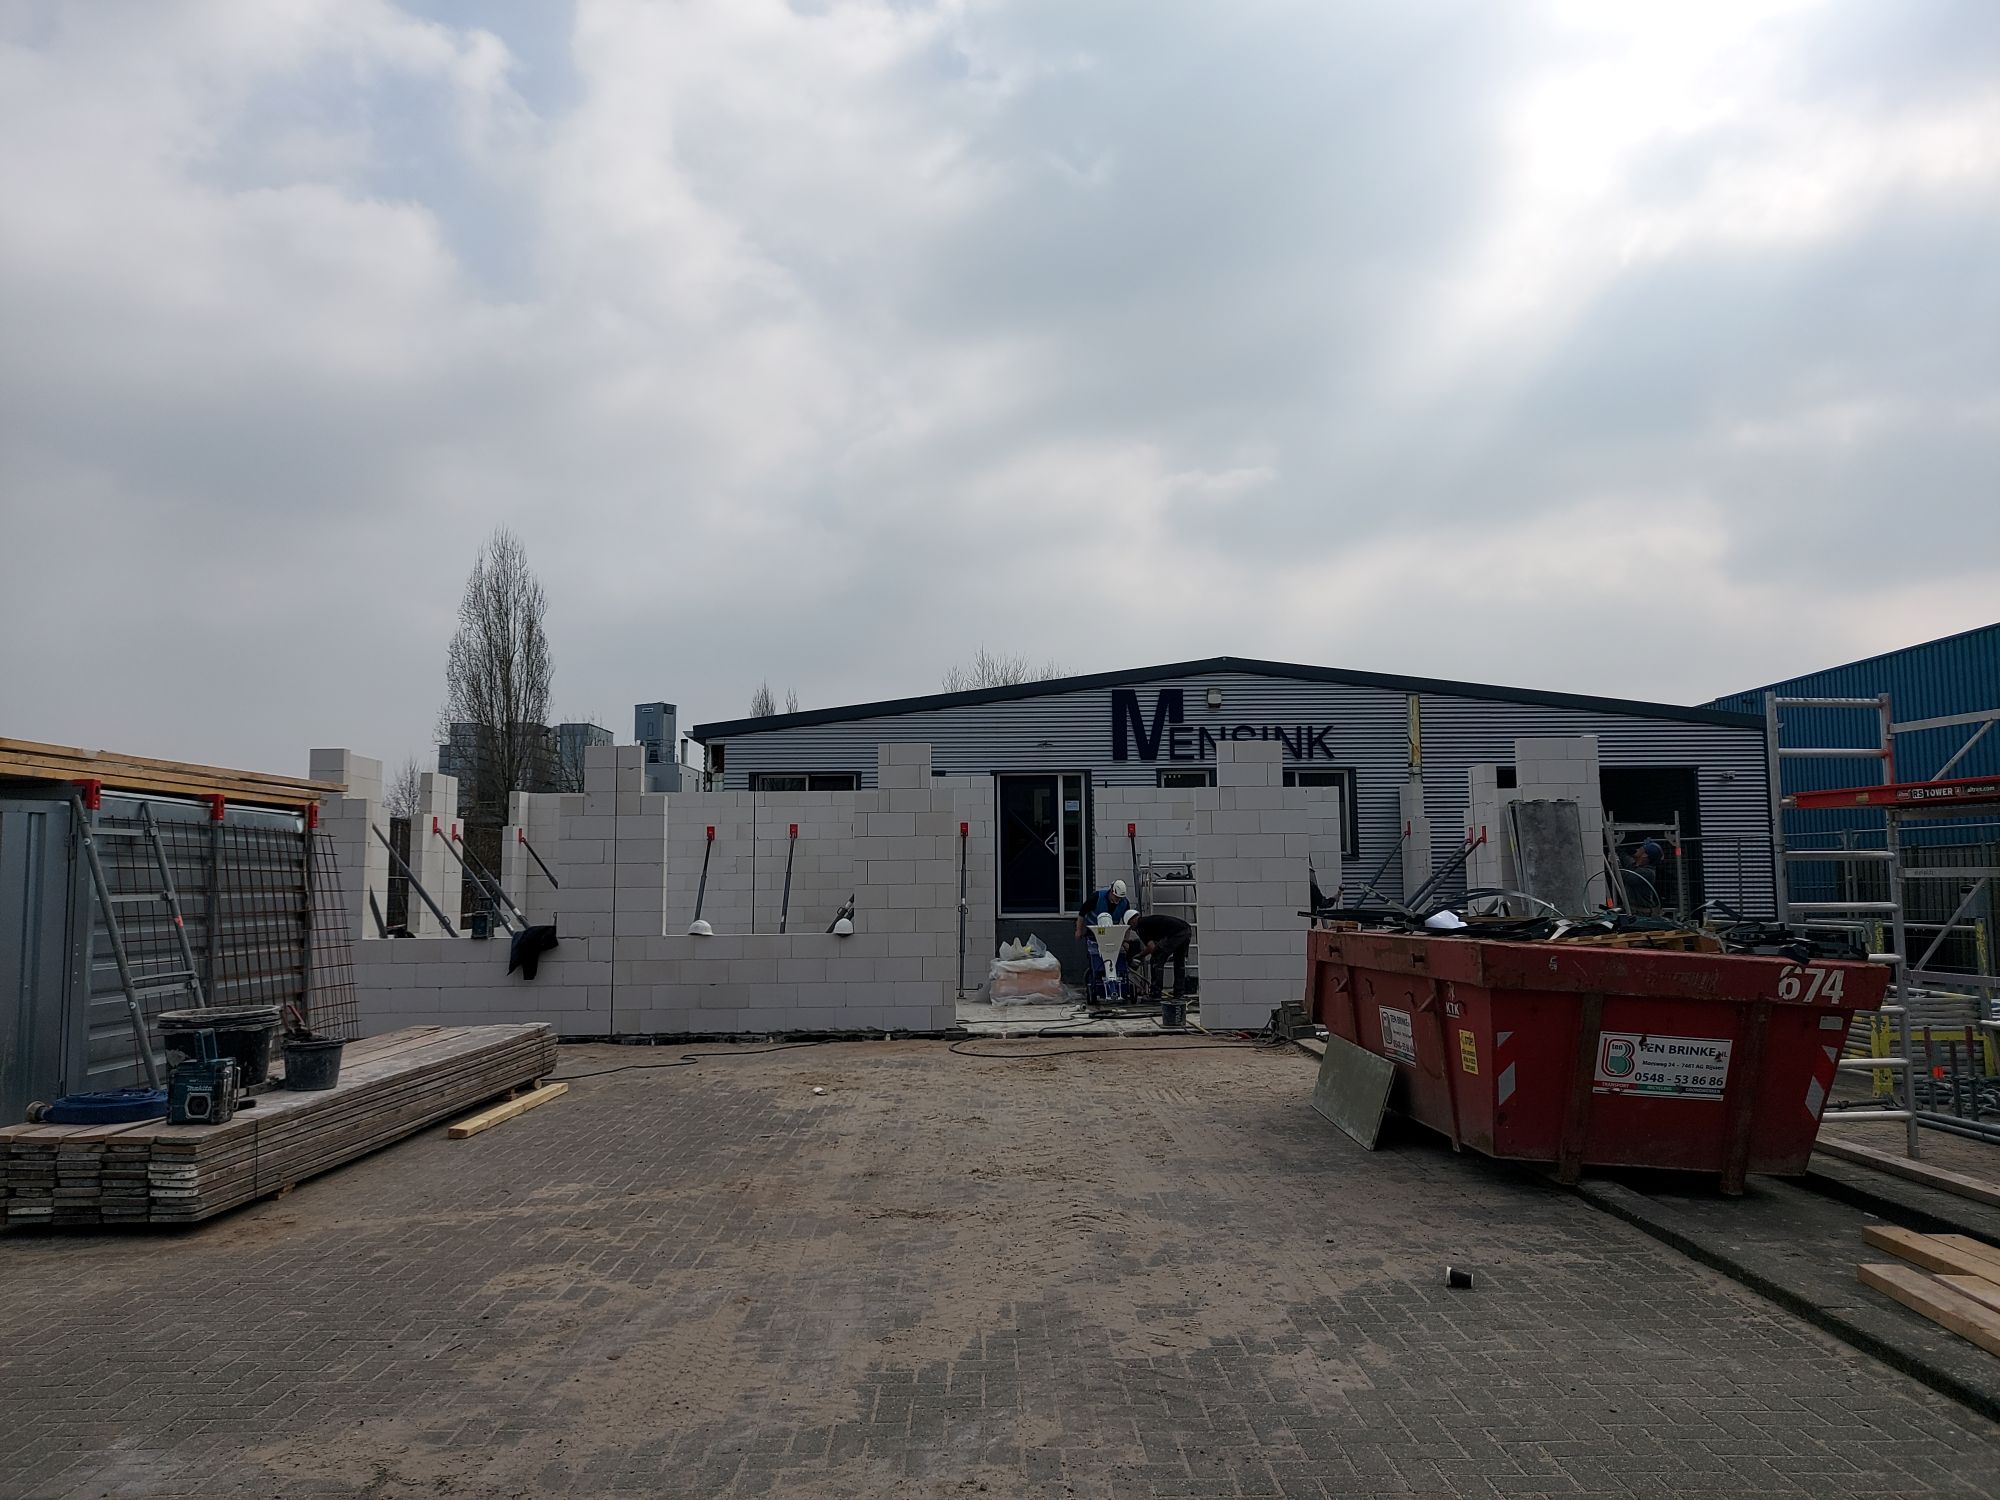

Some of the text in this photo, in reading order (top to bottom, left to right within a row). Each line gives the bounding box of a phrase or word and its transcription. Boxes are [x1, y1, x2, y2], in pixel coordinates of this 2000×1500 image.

[1913, 789, 1924, 798] RS
[1925, 787, 1953, 797] TOWER
[1778, 965, 1845, 1004] 674
[1445, 1001, 1460, 1016] KTK
[1634, 1072, 1664, 1083] 0548
[1673, 1075, 1689, 1084] 53
[1691, 1076, 1707, 1086] 86
[1708, 1076, 1724, 1086] 86
